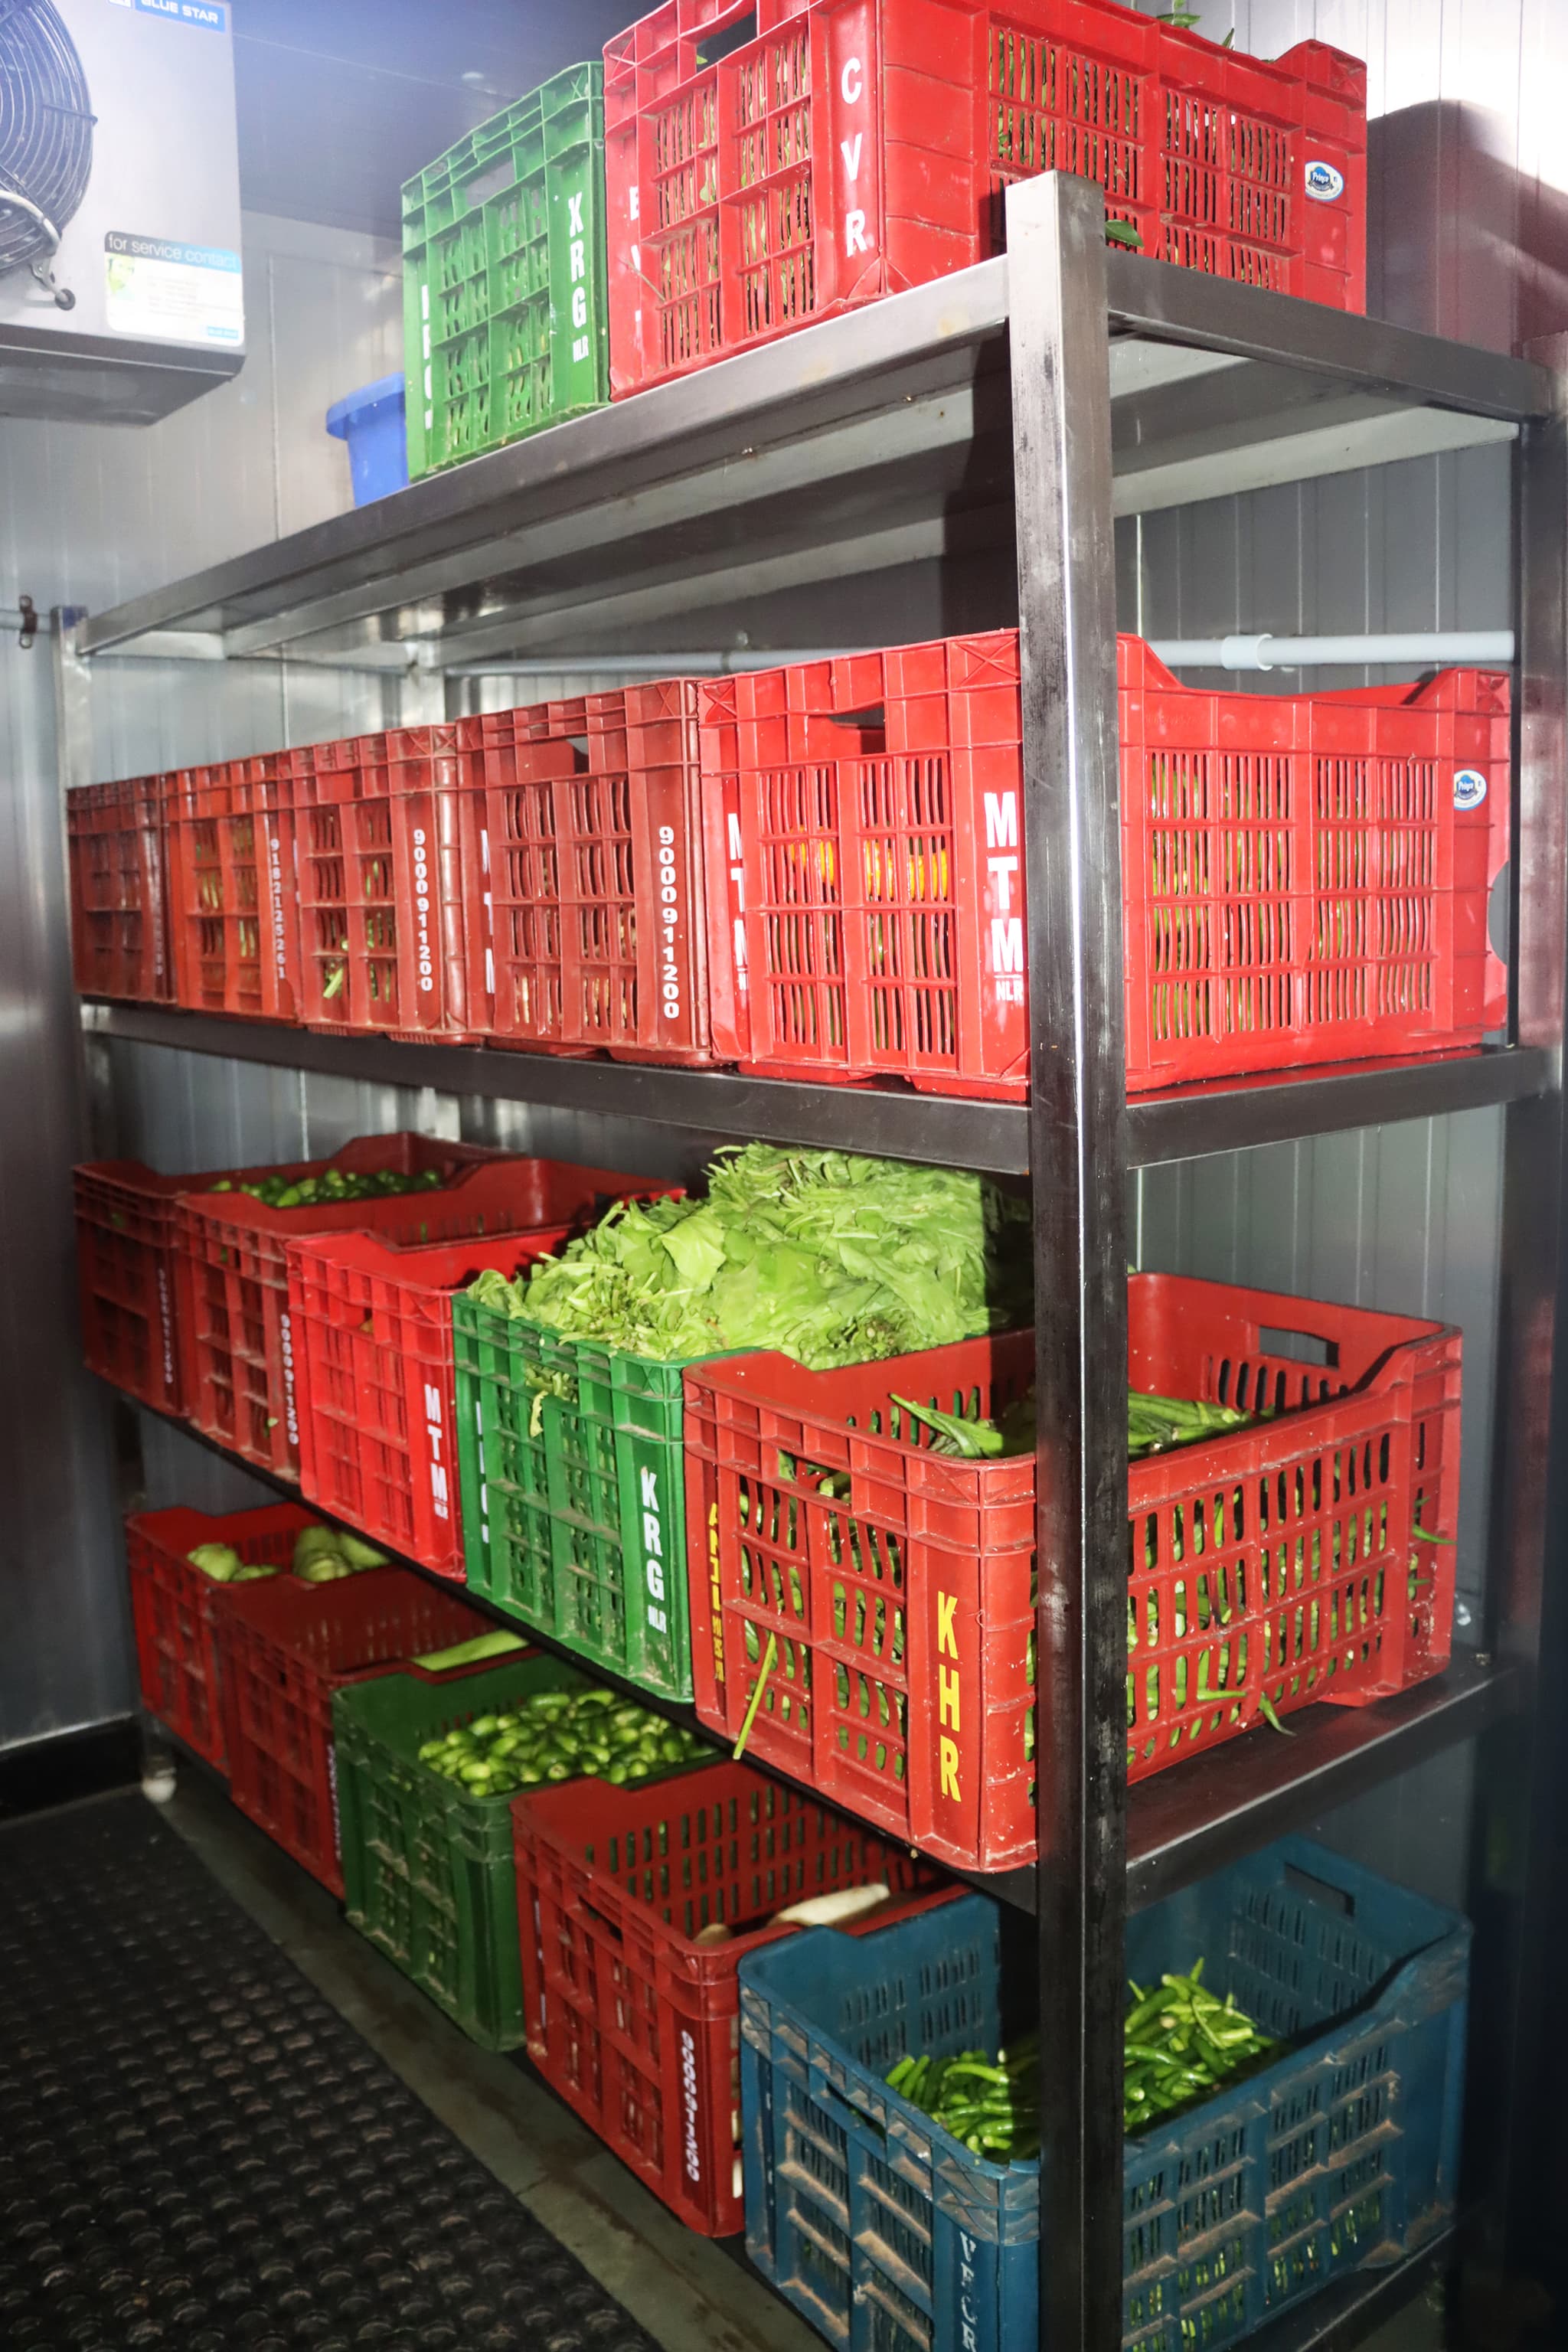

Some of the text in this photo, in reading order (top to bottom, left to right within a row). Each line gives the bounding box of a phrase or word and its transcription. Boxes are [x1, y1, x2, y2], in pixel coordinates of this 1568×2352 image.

[182, 5, 218, 24] STAR
[841, 57, 867, 257] CVR
[109, 234, 237, 270] for service contact
[413, 829, 433, 991] 9000911200
[658, 826, 680, 1019] 9000911200
[984, 792, 1023, 972] MTM
[996, 980, 1024, 1001] NLR
[424, 1384, 449, 1501] MTM
[641, 1466, 665, 1601] KRG
[938, 1590, 962, 1802] KHR
